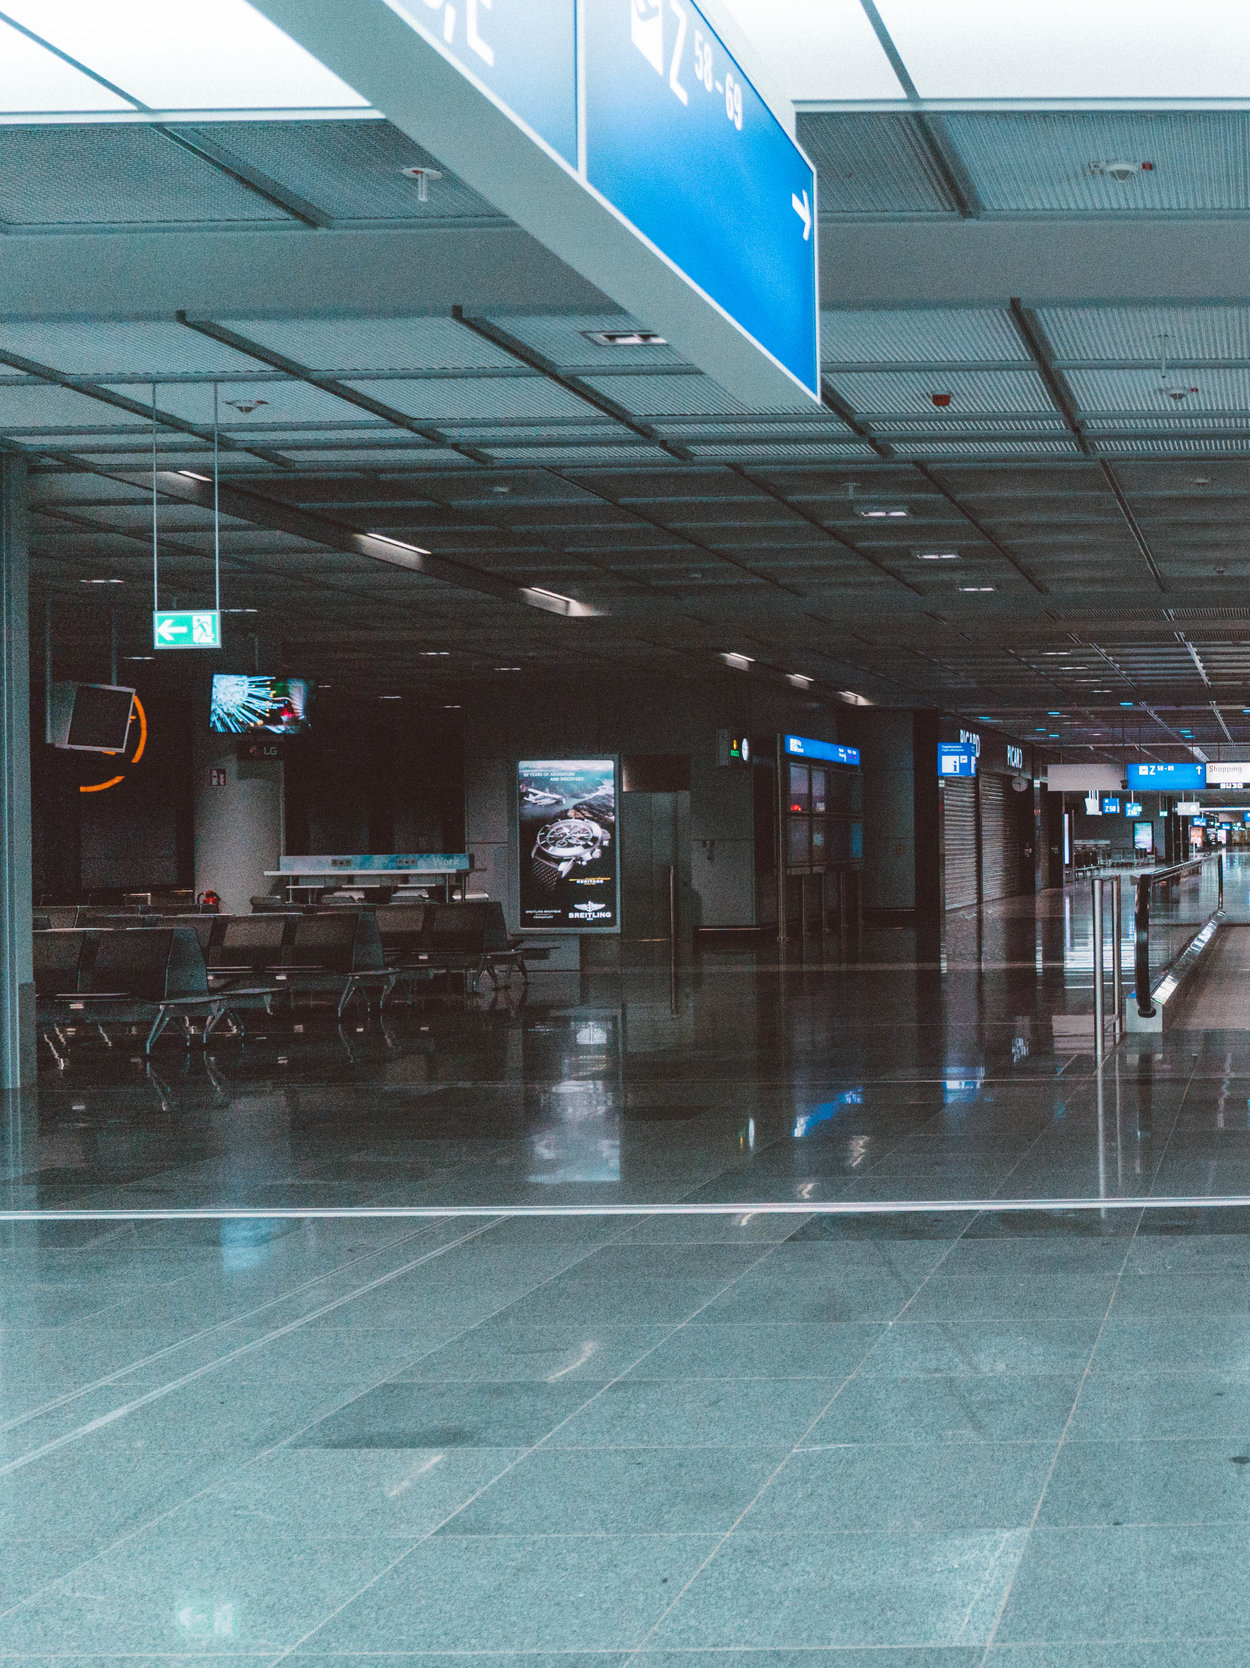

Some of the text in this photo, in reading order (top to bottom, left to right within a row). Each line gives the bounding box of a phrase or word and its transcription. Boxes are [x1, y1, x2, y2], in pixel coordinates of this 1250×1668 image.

[694, 28, 714, 93] 58
[725, 71, 743, 131] 69
[263, 746, 278, 755] LG
[1149, 765, 1156, 775] Z
[1208, 765, 1243, 774] Shopping
[568, 911, 612, 919] BREITLING
